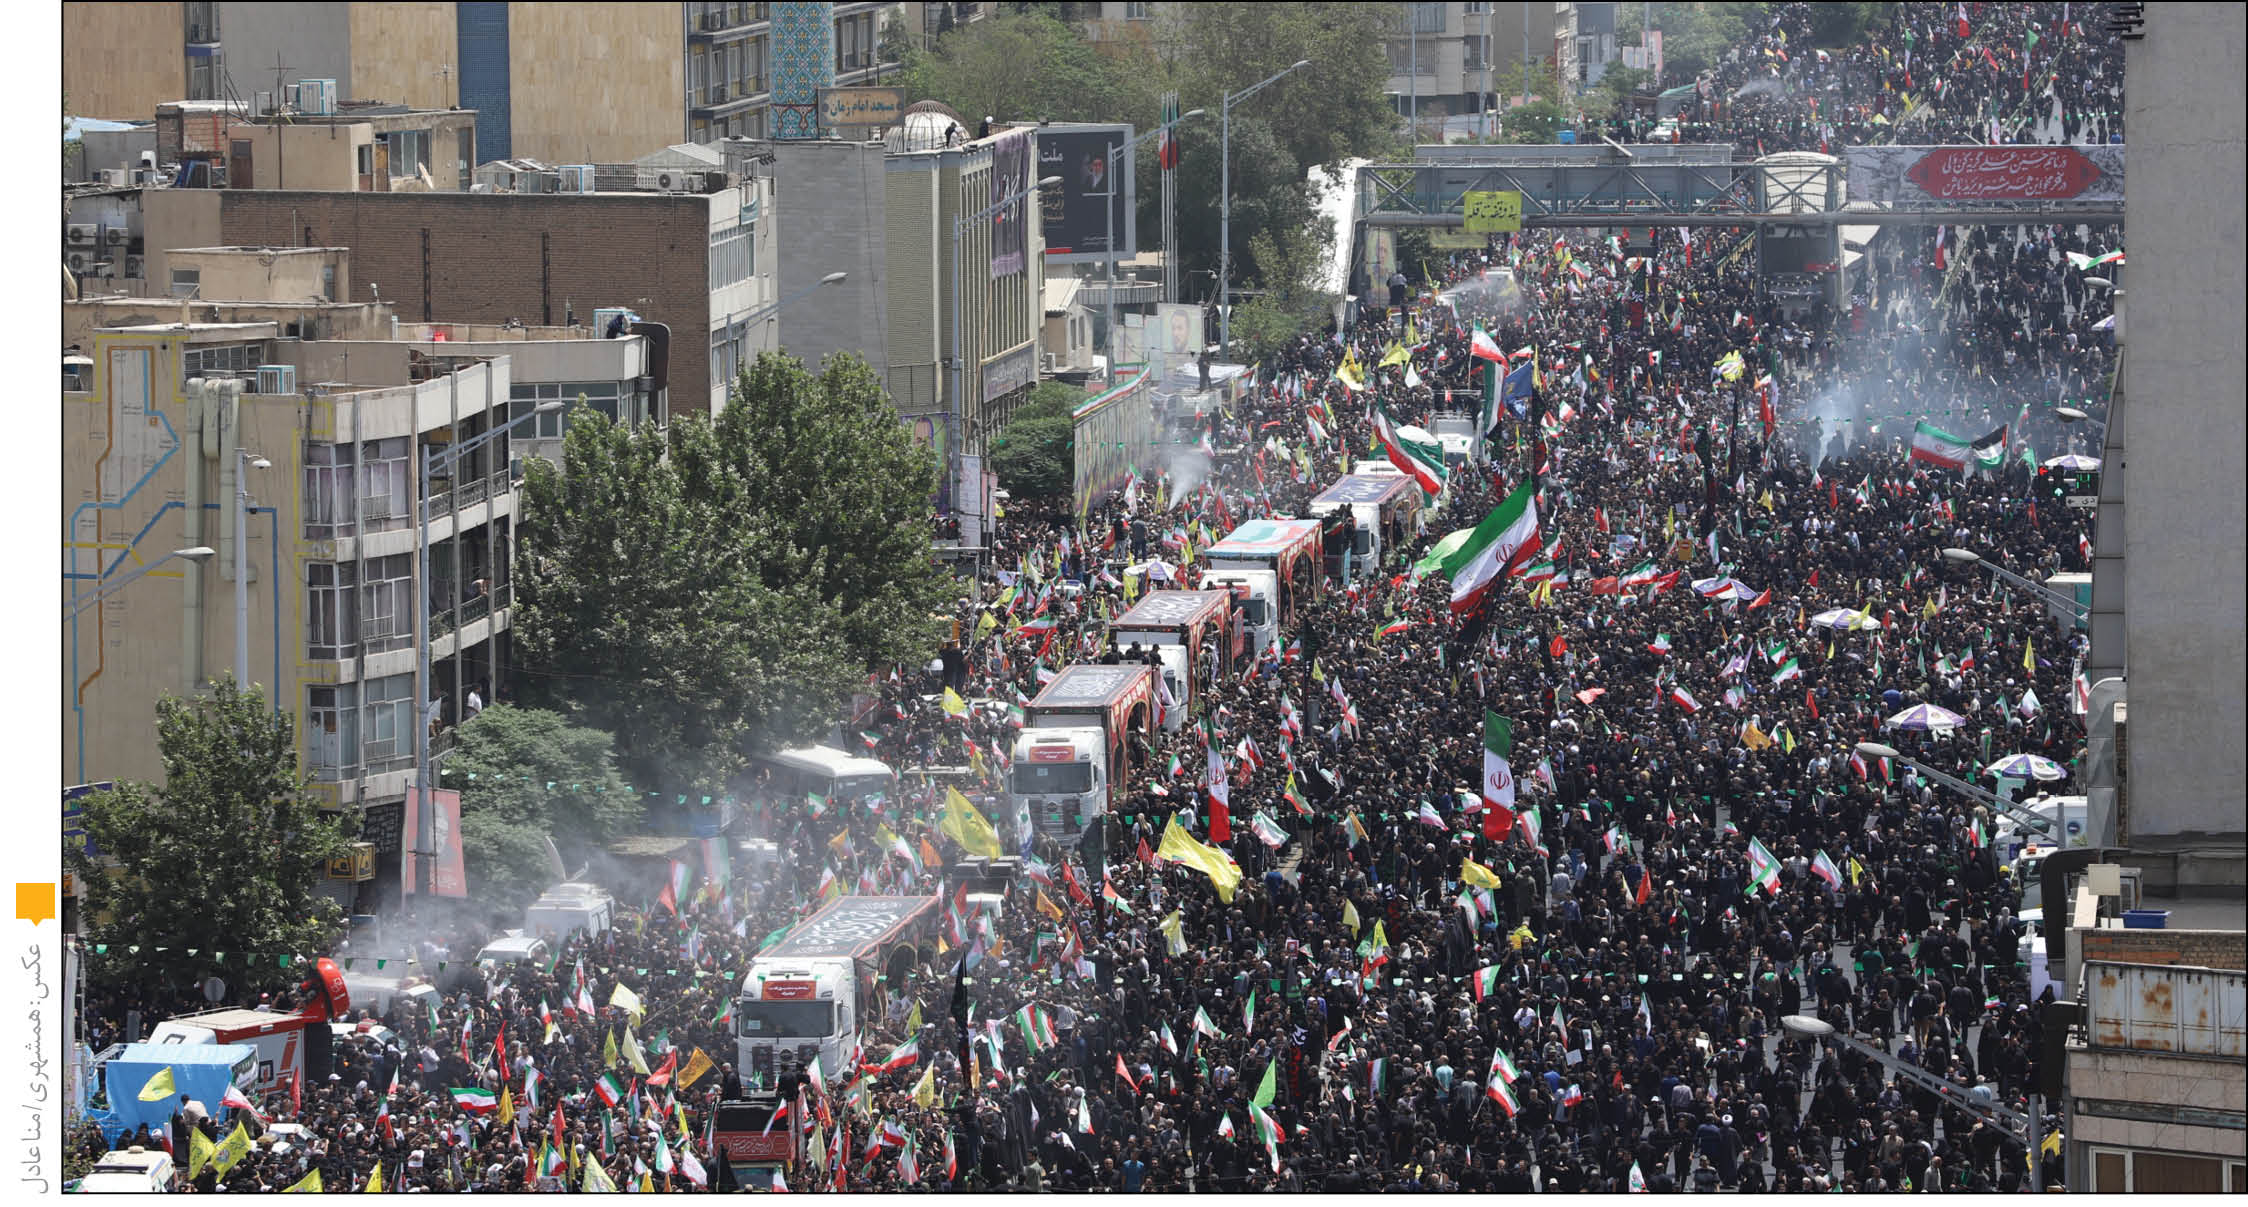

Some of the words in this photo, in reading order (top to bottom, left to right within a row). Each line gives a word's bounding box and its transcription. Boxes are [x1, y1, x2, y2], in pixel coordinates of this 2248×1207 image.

[829, 98, 850, 117] زمان
[852, 97, 870, 118] امام
[871, 99, 895, 114] مسجد
[1978, 151, 2018, 172] علی
[2009, 151, 2049, 174] حسین
